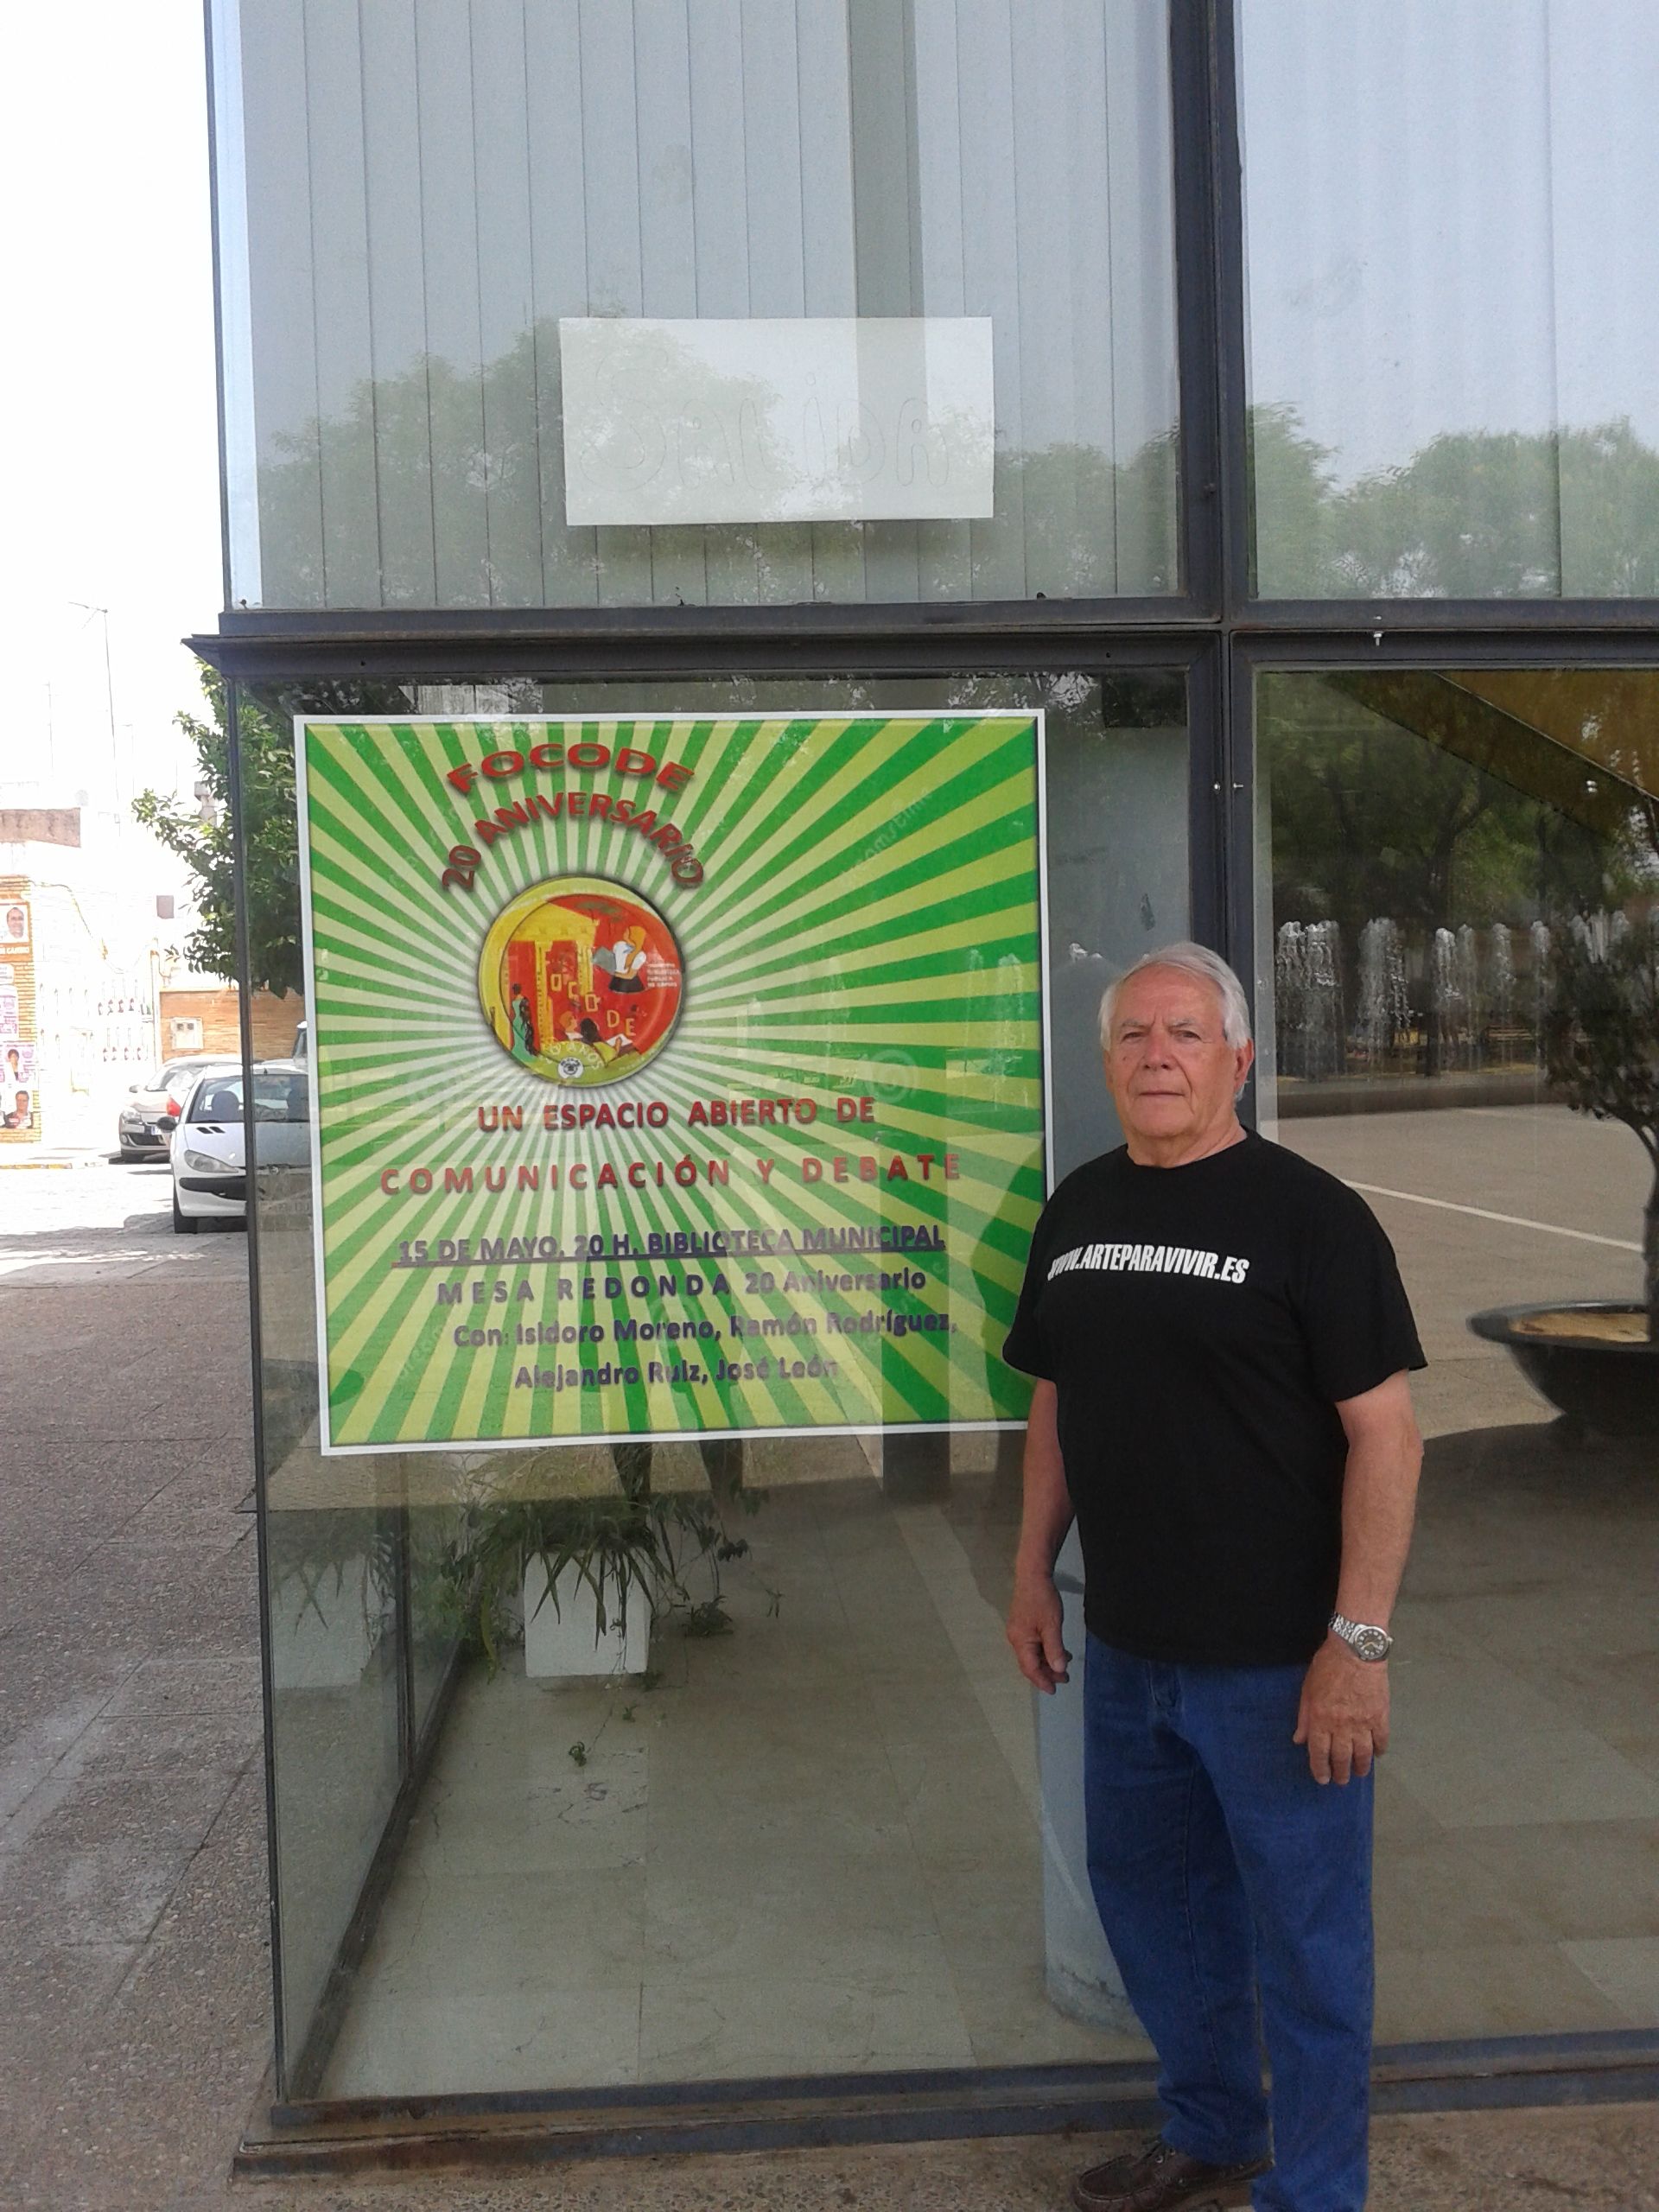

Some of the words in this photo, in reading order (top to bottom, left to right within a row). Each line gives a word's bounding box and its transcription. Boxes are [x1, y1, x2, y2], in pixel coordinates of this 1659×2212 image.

[447, 742, 695, 794] FOCODE
[442, 844, 481, 891] 20
[474, 791, 704, 887] ANIVERSARIO
[478, 1105, 524, 1132] UN
[543, 1101, 669, 1131] ESPACIO
[688, 1096, 817, 1127] ABIERTO
[836, 1096, 876, 1122] DE
[380, 1154, 729, 1196] COMUNICACIÓN
[757, 1158, 775, 1184] Y
[802, 1154, 961, 1184] DEBATE
[398, 1240, 429, 1262] 15
[438, 1239, 471, 1261] DE
[574, 1234, 603, 1258] 20
[647, 1228, 792, 1255] BIBLIOTECA
[803, 1224, 946, 1251] MUNICIPAL
[437, 1280, 534, 1306] MESA
[557, 1274, 730, 1300] REDONDA
[744, 1271, 776, 1294] 20
[783, 1267, 927, 1293] Aniversario
[516, 1320, 605, 1345] Isidoro
[613, 1317, 721, 1341] Moreno,
[730, 1312, 817, 1338] Ramón
[515, 1361, 639, 1392] Alejandro
[715, 1357, 770, 1381] José
[779, 1354, 838, 1380] León
